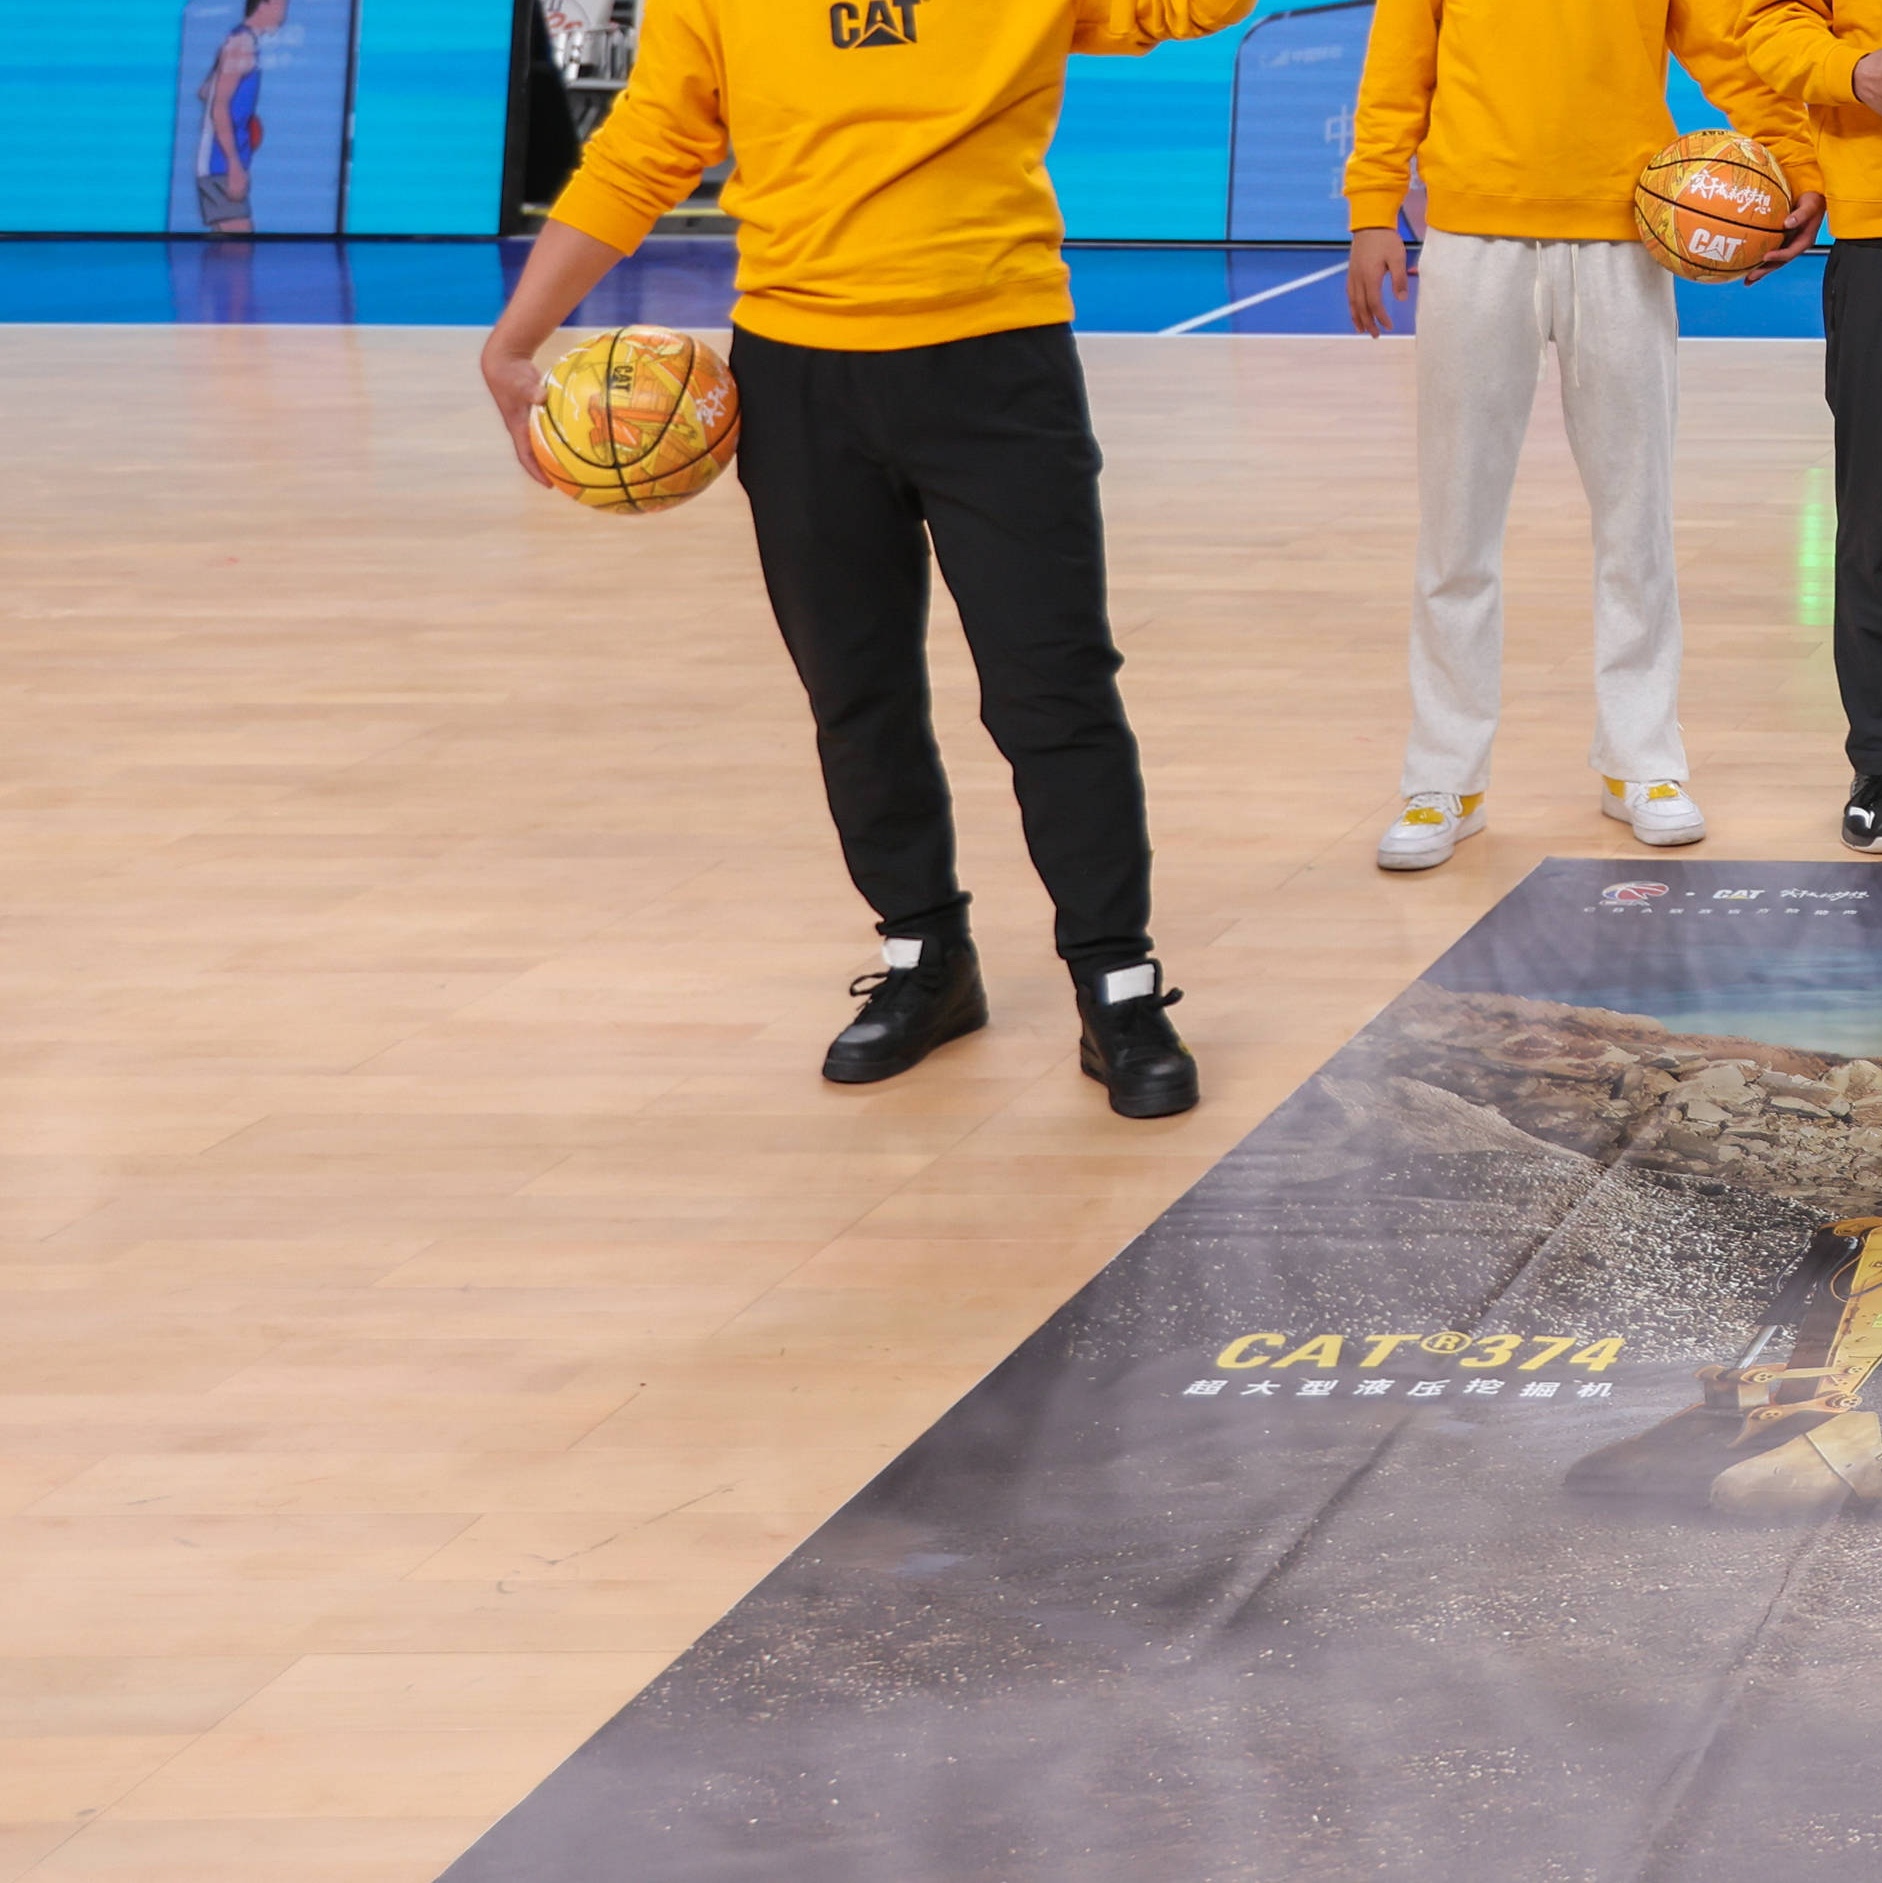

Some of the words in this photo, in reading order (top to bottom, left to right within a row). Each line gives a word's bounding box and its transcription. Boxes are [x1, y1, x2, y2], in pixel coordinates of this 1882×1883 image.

[1712, 889, 1765, 900] CAT
[1183, 1378, 1613, 1398] 超大型液压挖掘机
